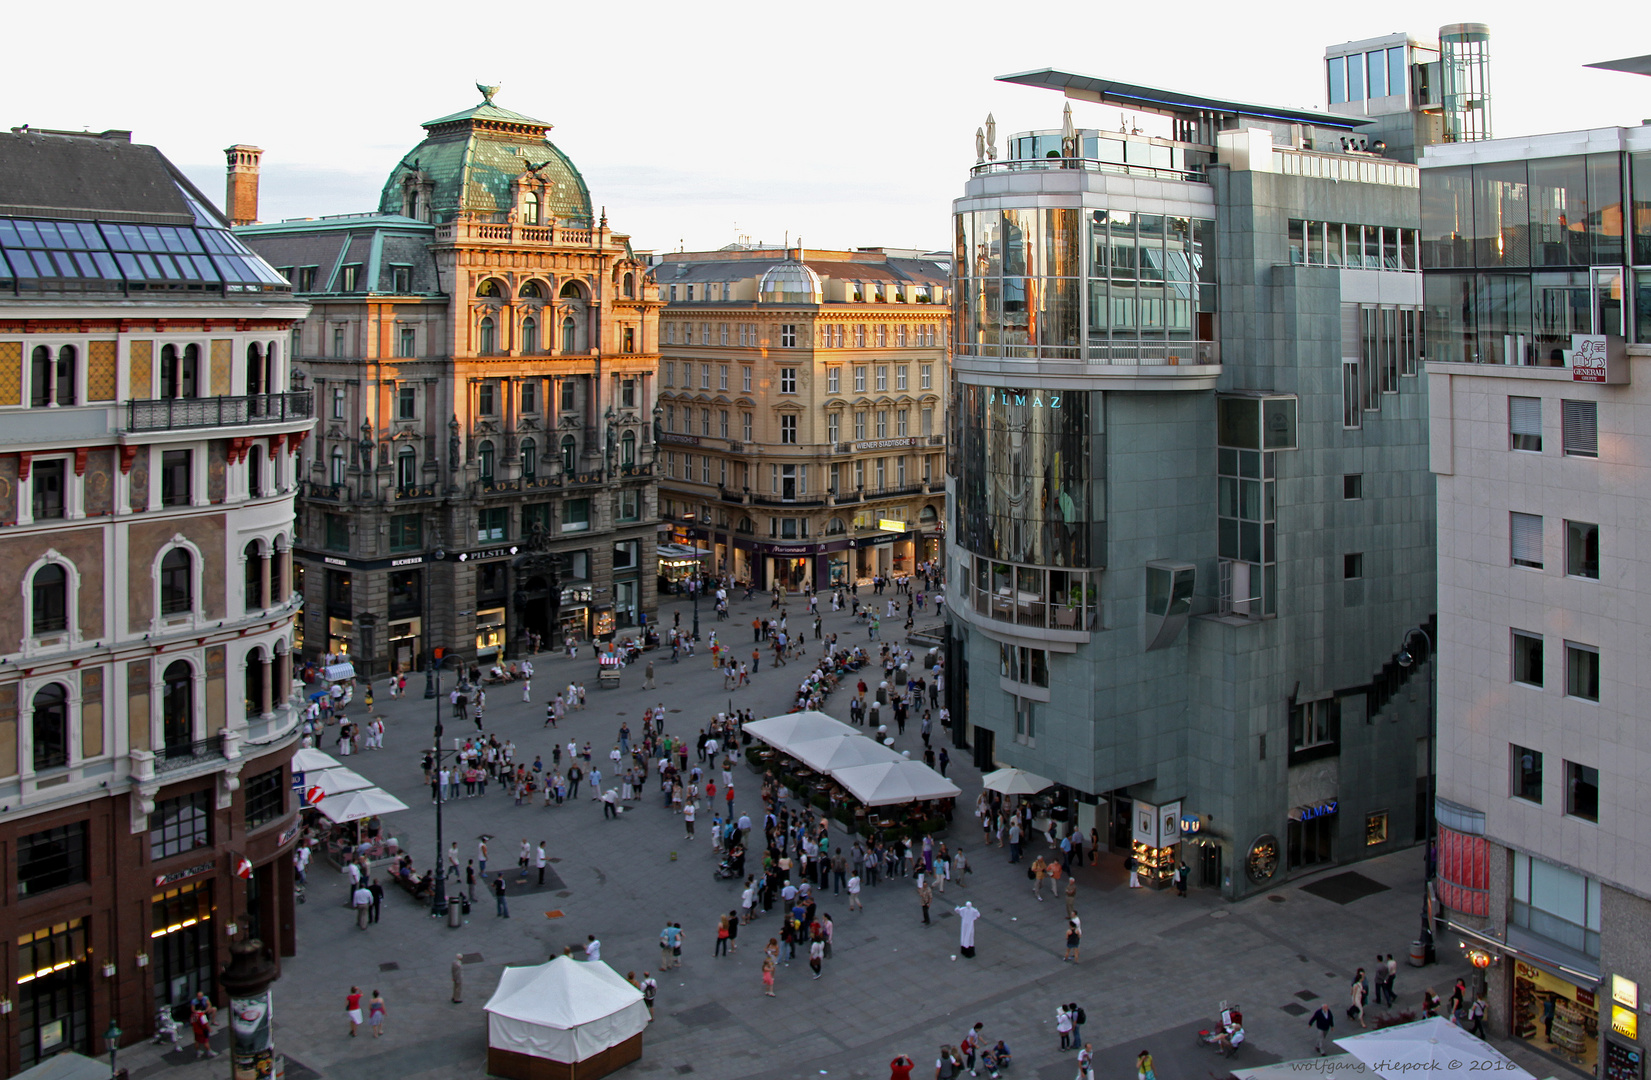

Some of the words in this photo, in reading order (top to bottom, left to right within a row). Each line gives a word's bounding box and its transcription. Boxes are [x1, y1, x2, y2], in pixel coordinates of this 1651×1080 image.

[1574, 368, 1605, 376] GENERALI
[990, 394, 1061, 409] ALMAZ
[856, 441, 878, 449] WIENER
[470, 549, 508, 560] PILSTL
[772, 545, 807, 553] Marionnaud
[391, 556, 423, 567] BUCHERER
[1301, 801, 1338, 821] ALMAZ
[166, 870, 188, 883] Bank
[1614, 992, 1635, 1005] Canon
[1612, 1022, 1636, 1039] Nikon
